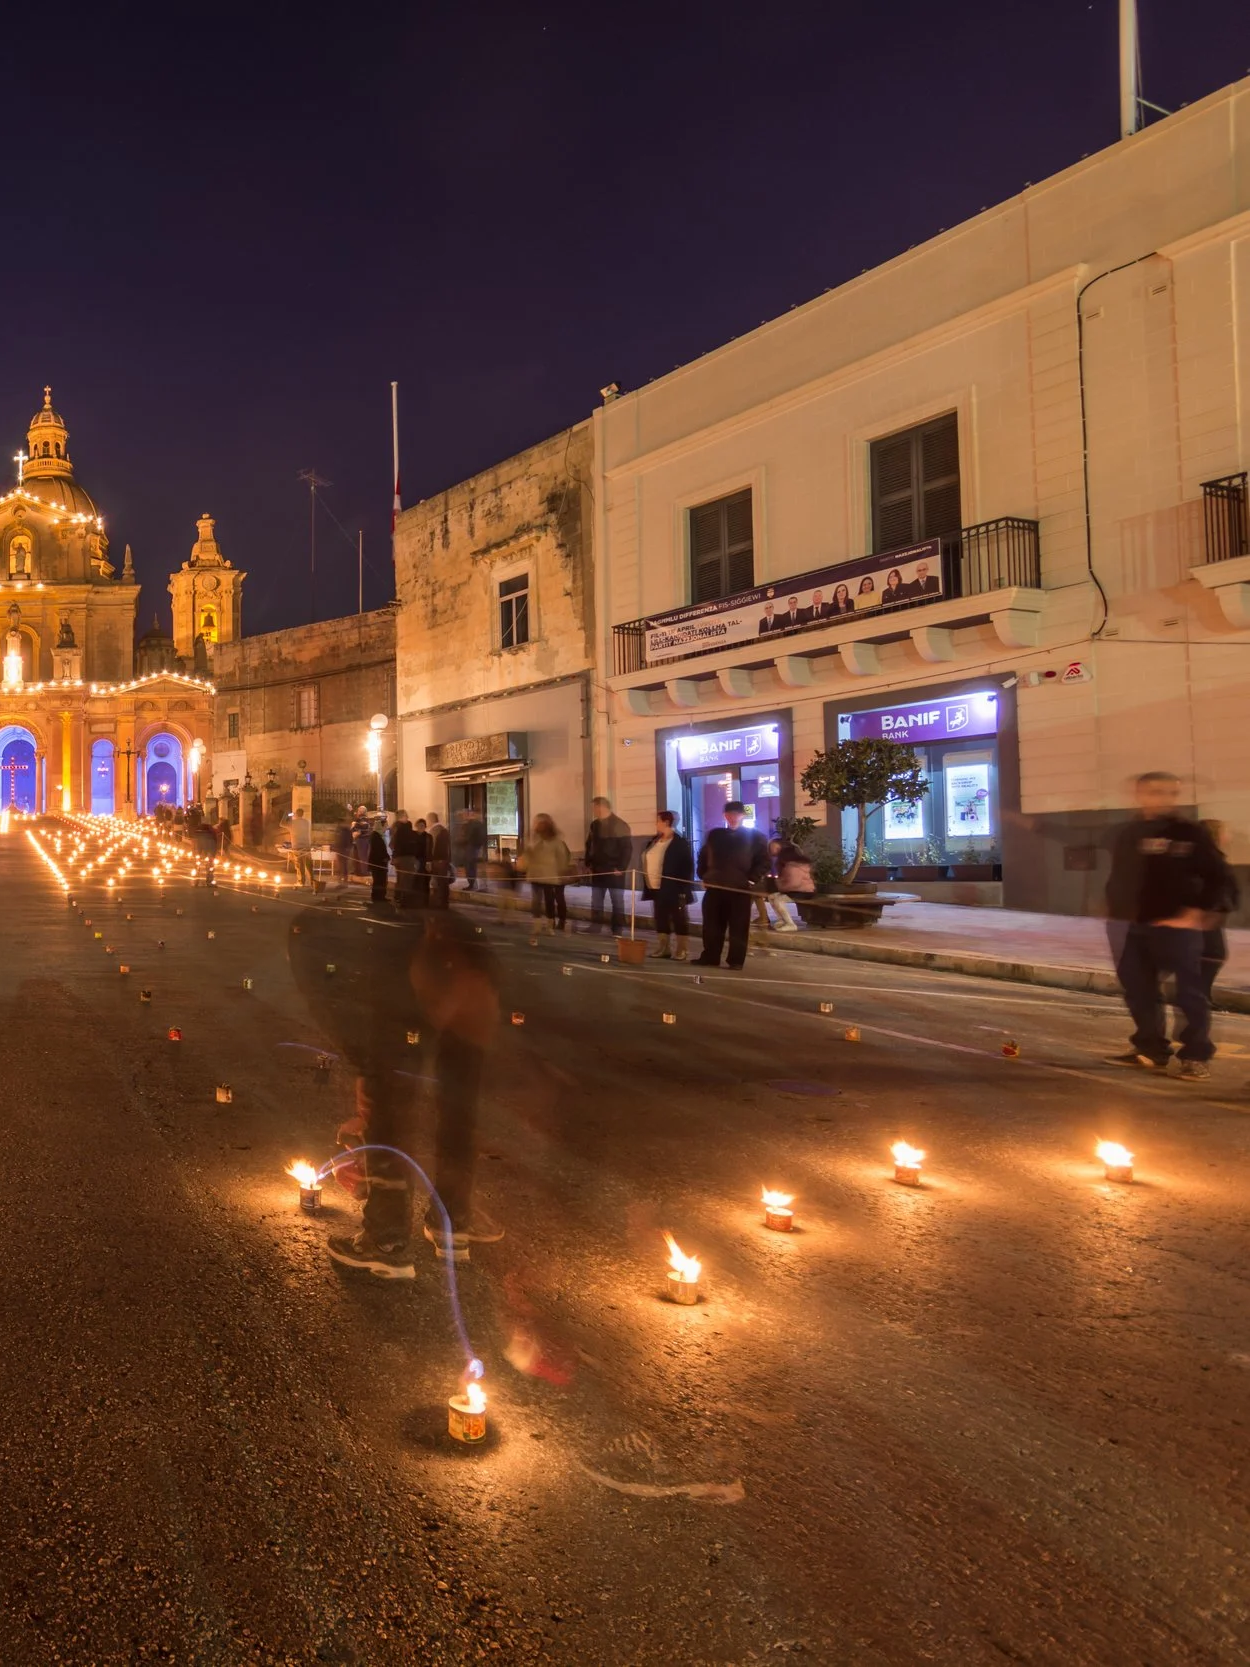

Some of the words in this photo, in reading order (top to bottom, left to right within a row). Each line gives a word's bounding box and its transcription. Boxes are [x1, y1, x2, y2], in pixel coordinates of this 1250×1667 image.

[679, 605, 718, 620] DIFFERENZA
[727, 619, 743, 627] TAL-
[677, 624, 696, 633] APRIL
[650, 641, 672, 651] PARTIT
[881, 710, 940, 730] BANIF
[882, 730, 909, 740] BANK
[699, 738, 741, 754] BANIF
[699, 754, 719, 763] BANK
